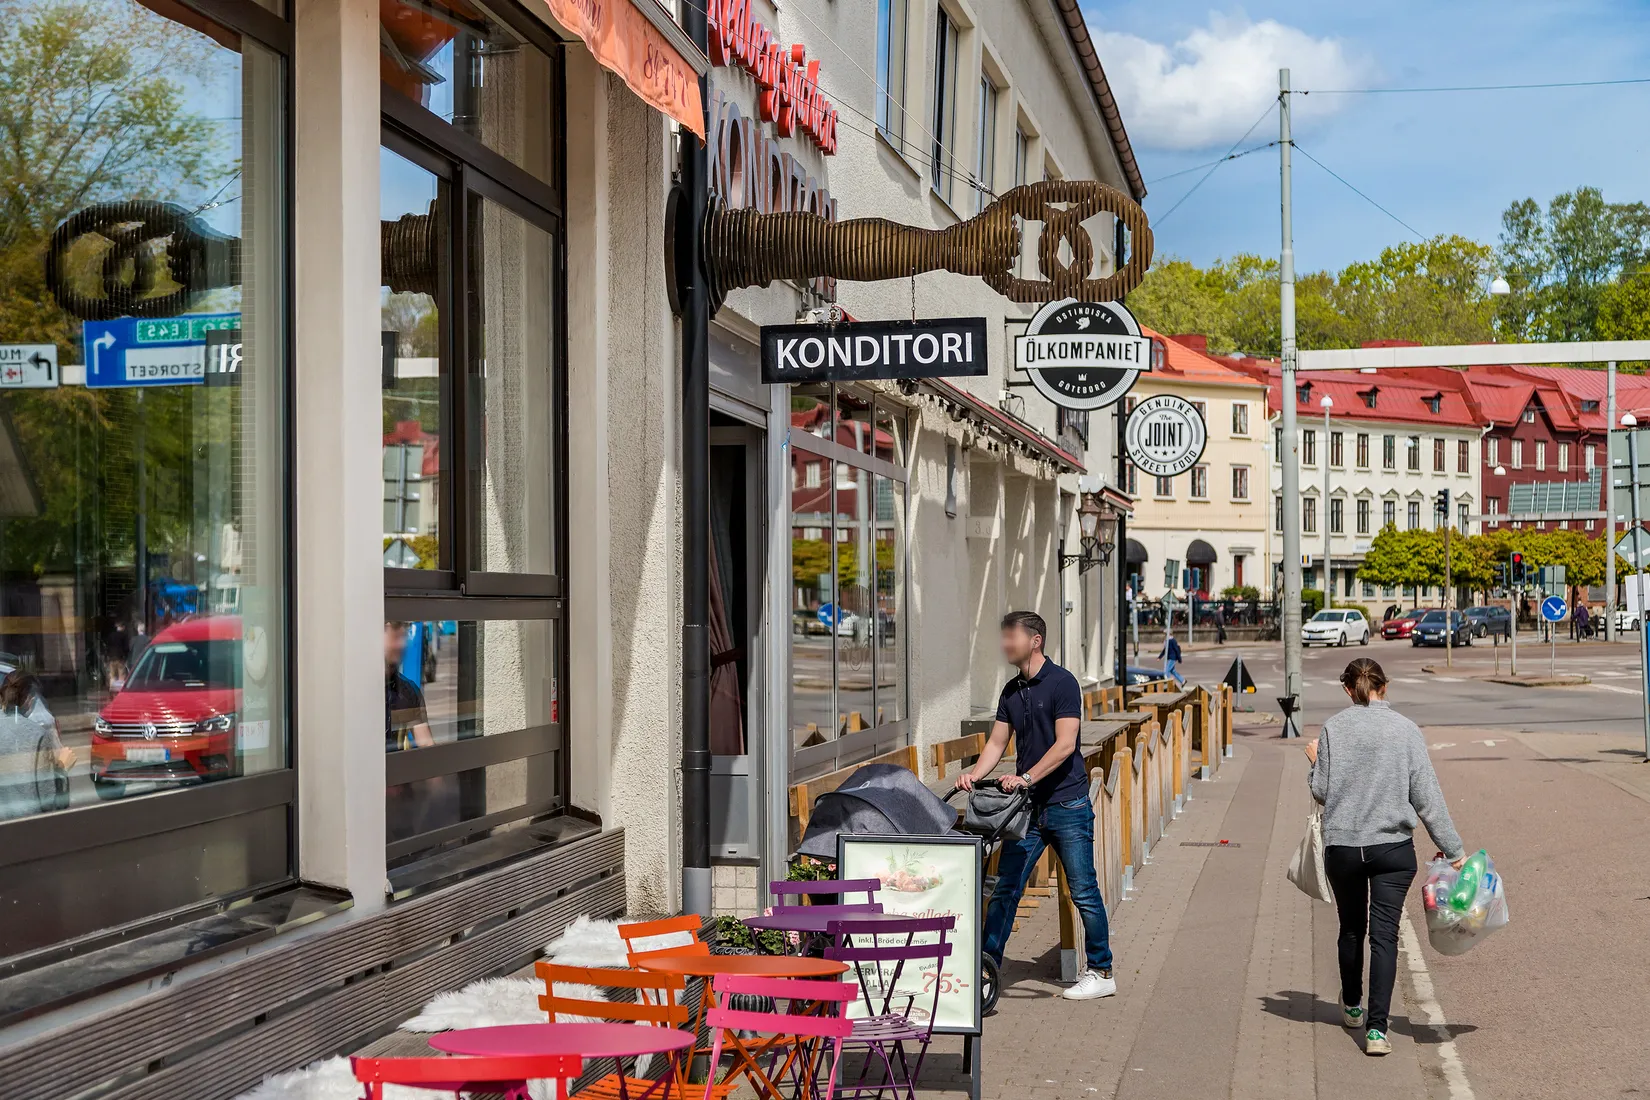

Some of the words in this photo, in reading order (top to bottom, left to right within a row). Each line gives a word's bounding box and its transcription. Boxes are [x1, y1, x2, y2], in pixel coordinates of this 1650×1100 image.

[1056, 307, 1112, 324] OSTINDISKA
[777, 332, 972, 369] KONDITORI
[1026, 338, 1142, 363] ÖLKOMPANIET
[1139, 399, 1192, 416] GENUINE
[1145, 422, 1183, 447] JOINT
[1132, 449, 1167, 473] STREET
[1172, 450, 1197, 472] FOOD
